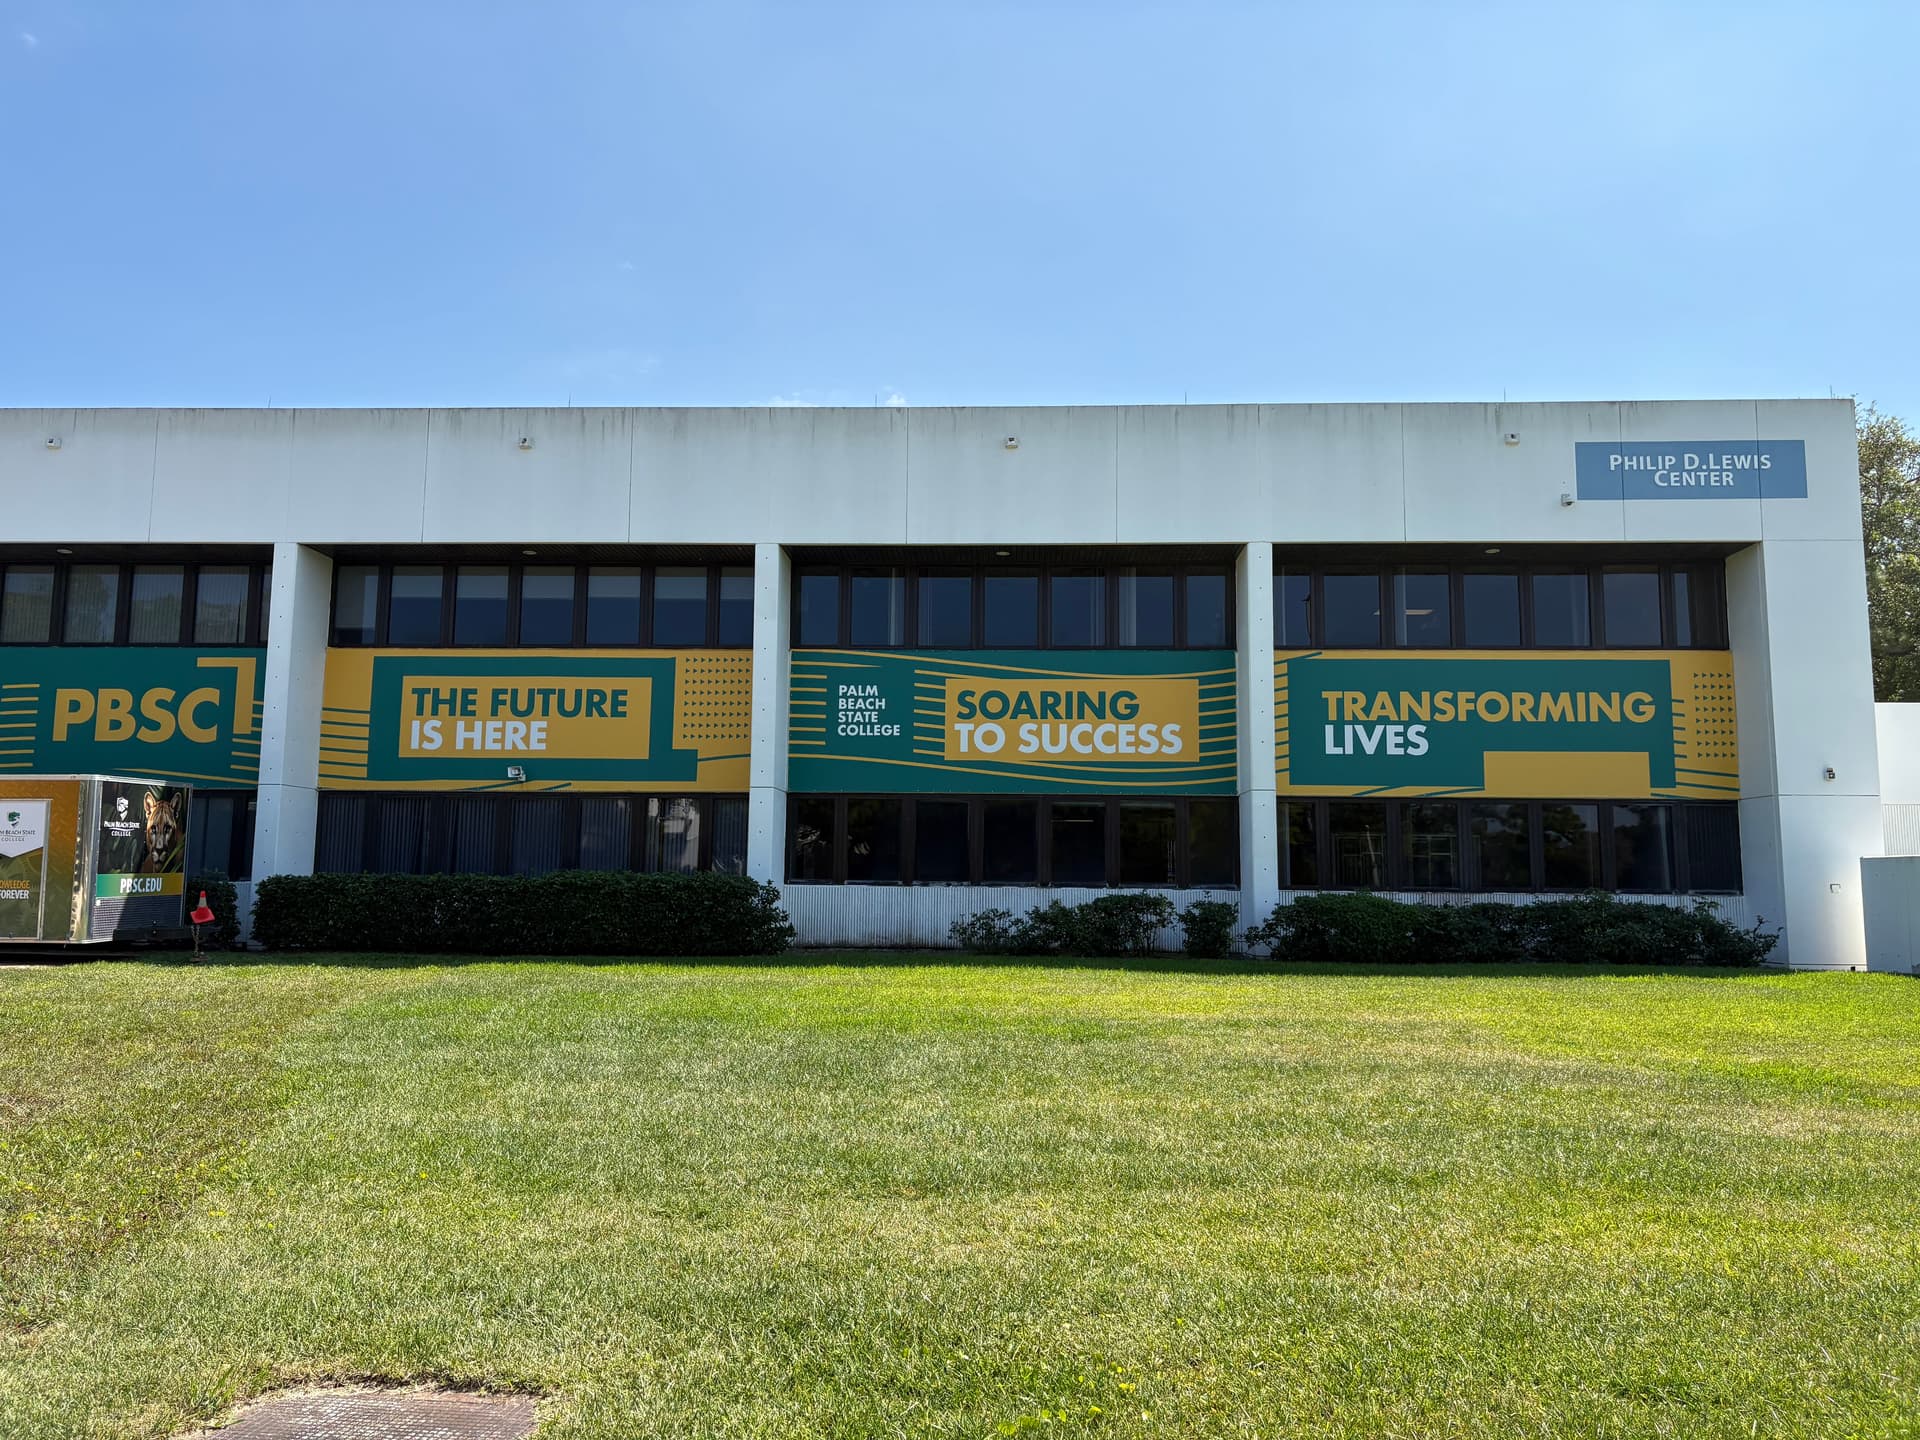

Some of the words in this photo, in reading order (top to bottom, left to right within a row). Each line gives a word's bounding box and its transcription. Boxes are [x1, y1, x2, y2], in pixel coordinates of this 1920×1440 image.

[1609, 453, 1676, 471] PHILIP
[1654, 470, 1735, 487] CENTER
[411, 687, 479, 718] THE
[489, 687, 629, 719] FUTURE
[839, 685, 878, 697] PALM
[53, 688, 219, 742] PBSC
[838, 698, 886, 710] BEACH
[956, 689, 1140, 721] SOARING
[1323, 691, 1655, 723] TRANSFORMING
[838, 711, 878, 723] STATE
[410, 719, 443, 750] IS
[455, 720, 548, 750] HERE
[837, 724, 900, 736] COLLEGE
[954, 722, 1006, 753] TO
[1018, 723, 1183, 755] SUCCESS
[1325, 724, 1429, 756] LIVES
[120, 877, 162, 894] PBSC.EDU
